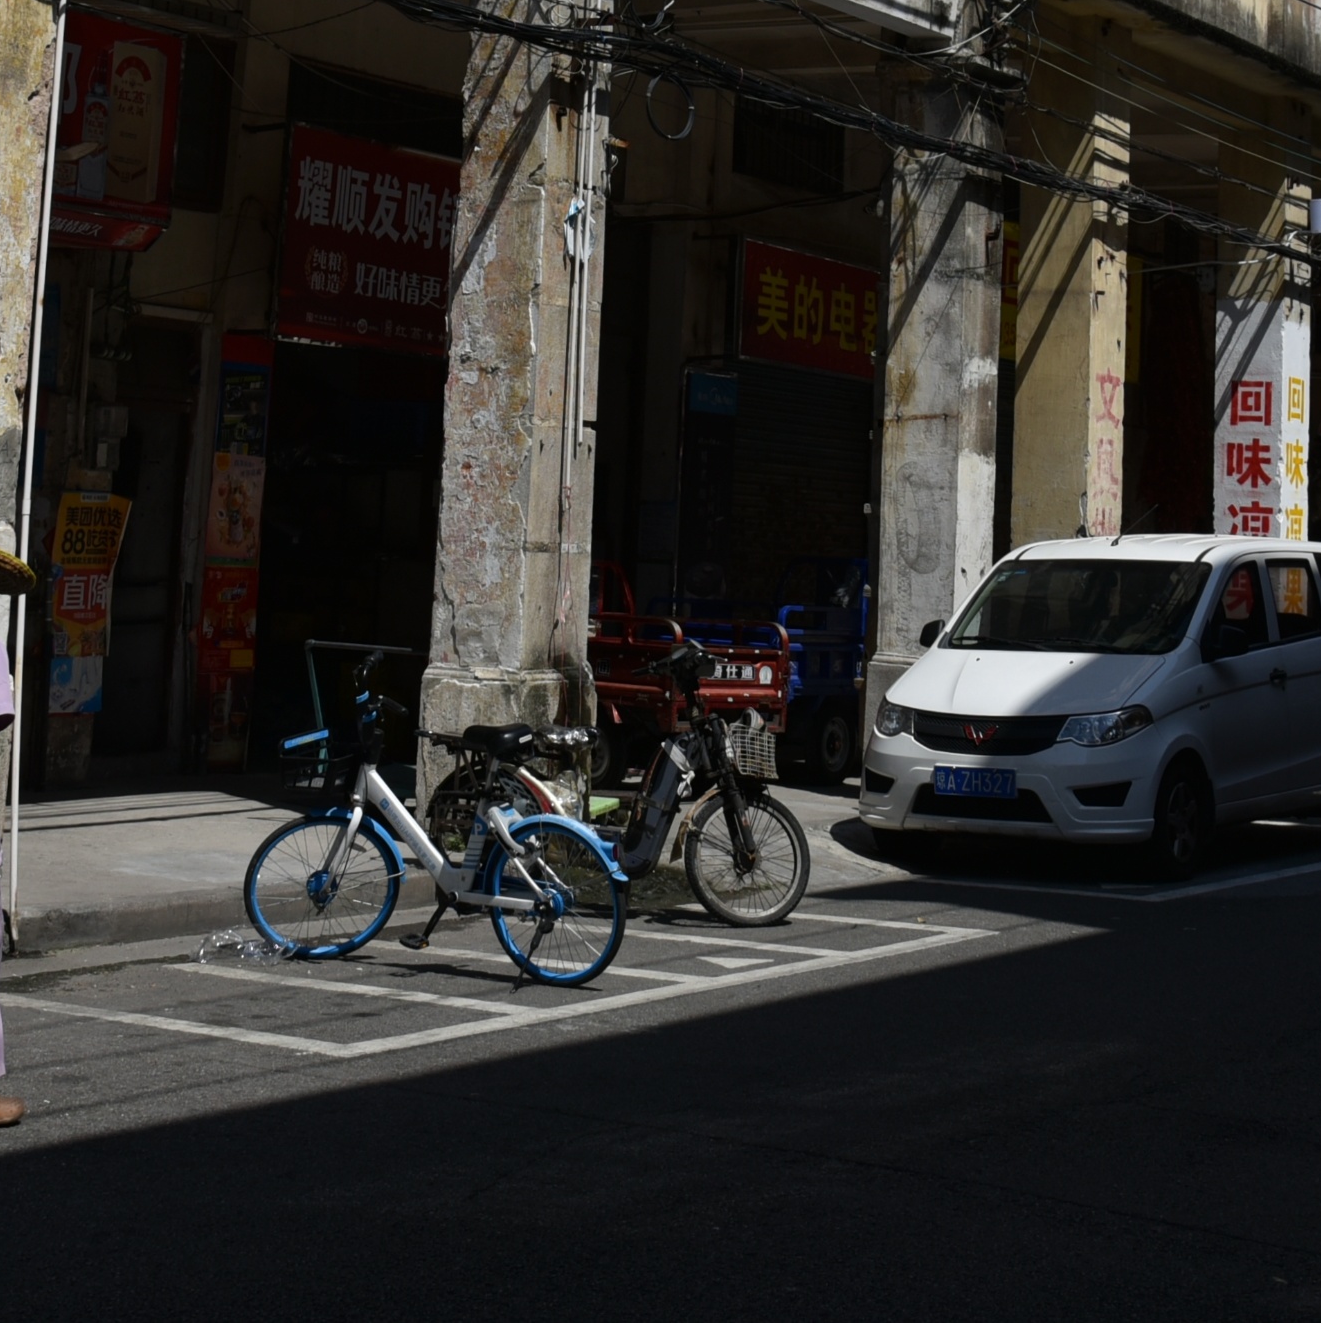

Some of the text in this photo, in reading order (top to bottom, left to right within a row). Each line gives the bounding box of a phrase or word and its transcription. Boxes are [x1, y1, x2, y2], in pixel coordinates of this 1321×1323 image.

[354, 262, 449, 310] 好味情更
[65, 506, 123, 529] 美团优选
[60, 573, 108, 610] 直降
